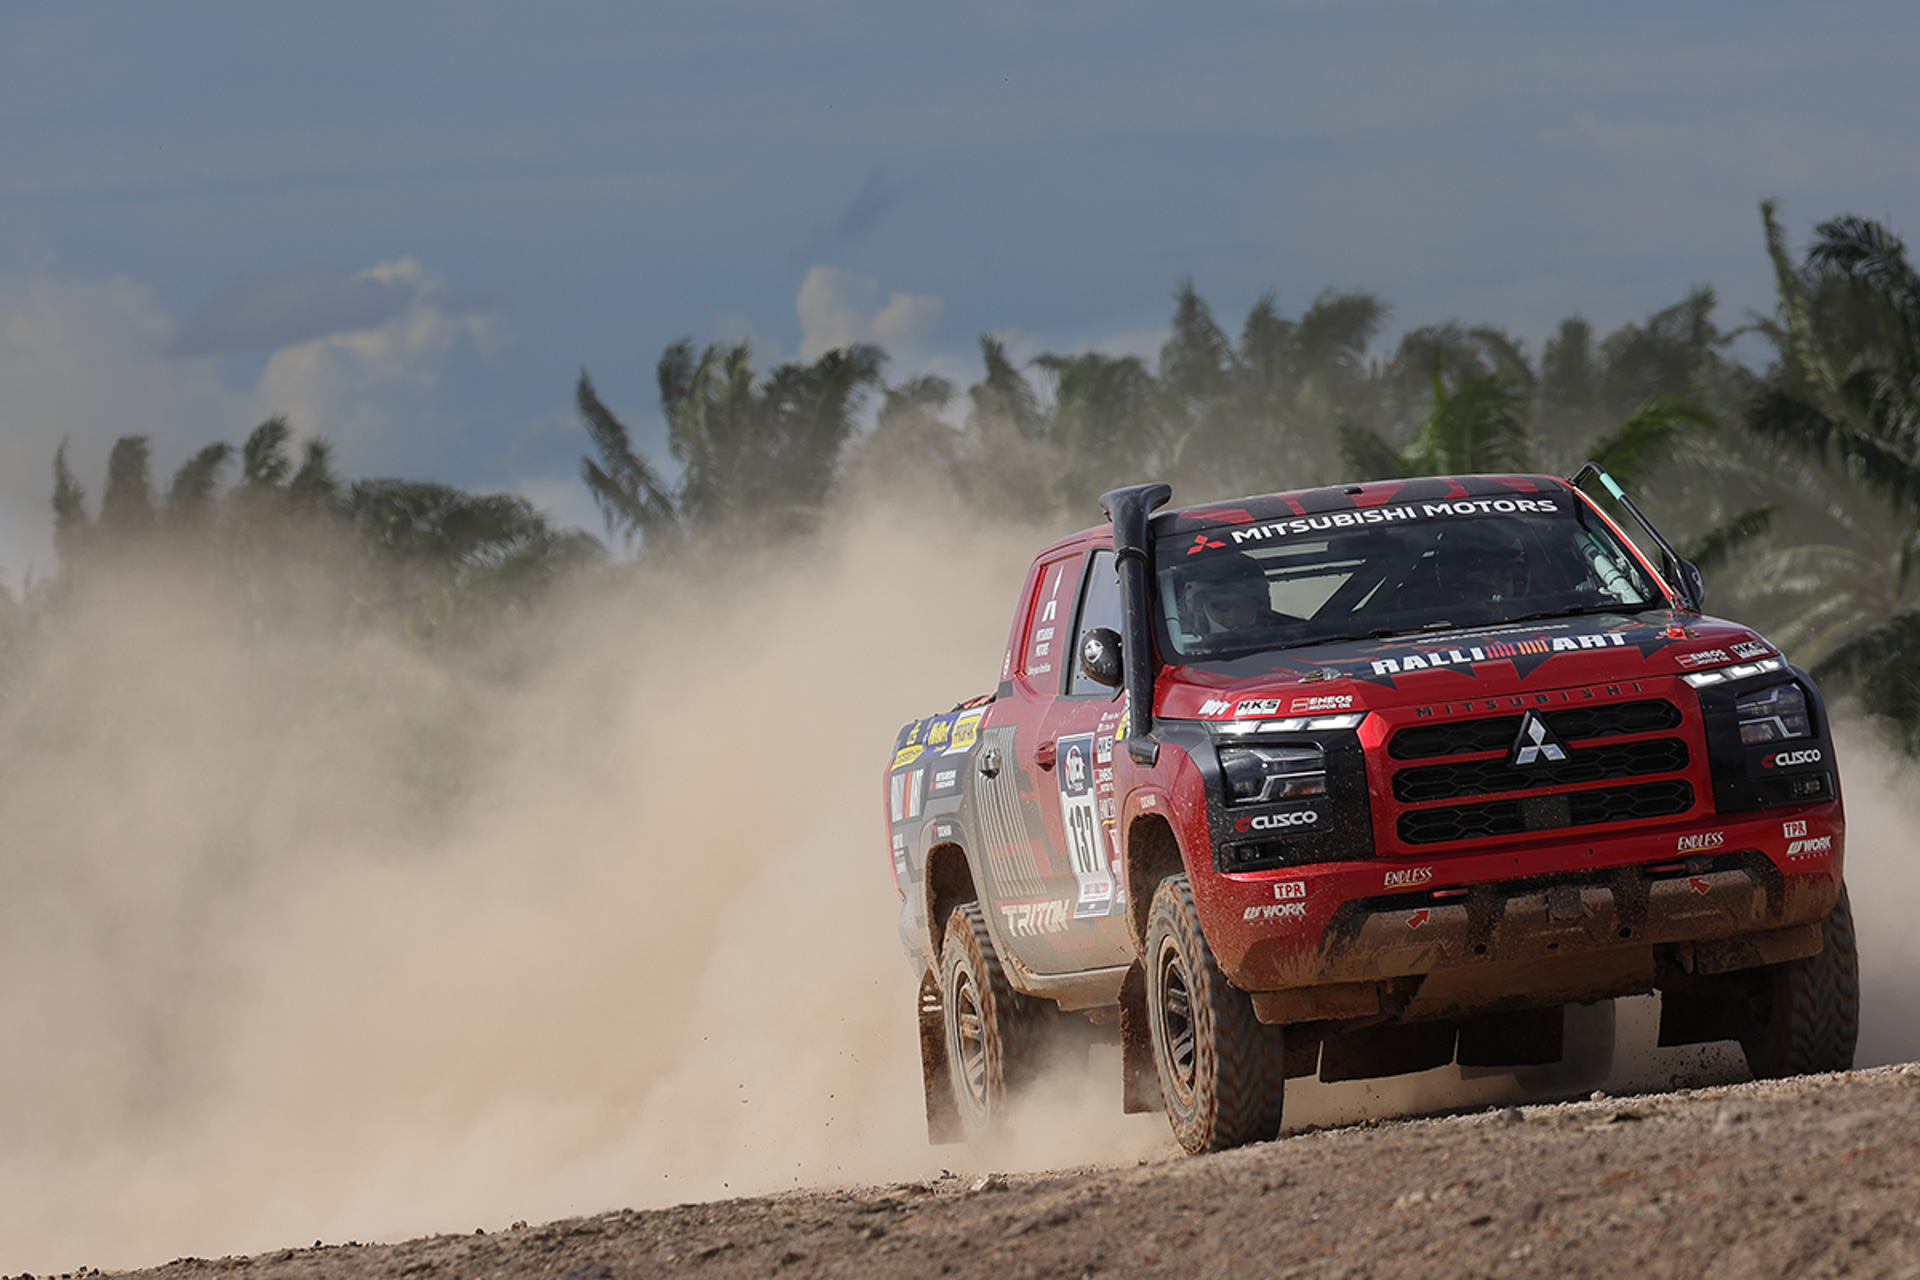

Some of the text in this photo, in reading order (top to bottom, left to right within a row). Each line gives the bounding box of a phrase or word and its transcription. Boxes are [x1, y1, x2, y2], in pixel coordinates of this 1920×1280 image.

[1231, 500, 1559, 544] MITSUBISHI MOTORS
[1236, 699, 1280, 711] HKS
[1309, 694, 1353, 706] ENEOS
[1416, 682, 1643, 719] MITSUBISHI
[1785, 821, 1805, 837] TPR
[1069, 805, 1099, 873] 137
[1678, 832, 1725, 851] ENDLESS
[1384, 867, 1433, 885] ENDLESS
[1276, 883, 1305, 898] TPR
[1001, 899, 1069, 937] TRITON
[1260, 902, 1308, 918] WORK
